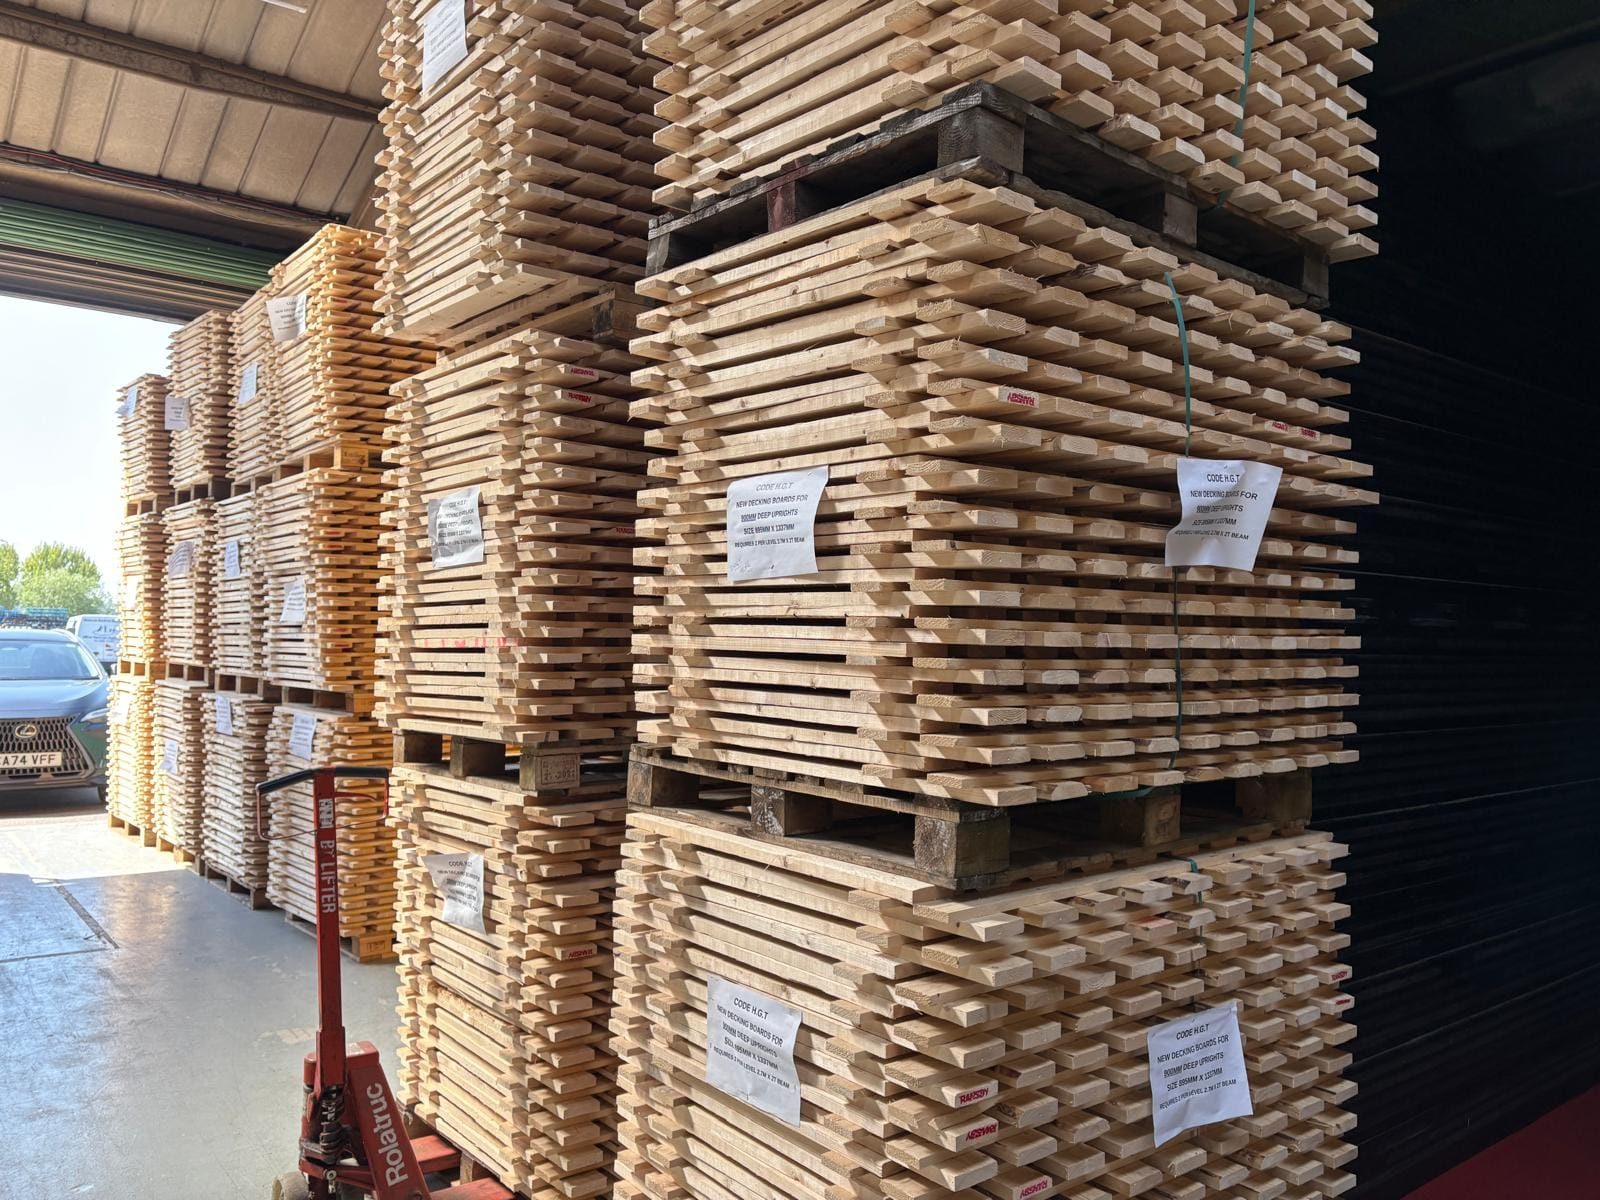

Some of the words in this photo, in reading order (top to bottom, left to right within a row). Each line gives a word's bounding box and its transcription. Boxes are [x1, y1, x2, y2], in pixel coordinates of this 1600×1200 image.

[1206, 474, 1223, 483] CODE
[756, 484, 775, 492] CODE
[748, 498, 771, 507] DECKING
[772, 496, 795, 504] BOARDS
[796, 494, 808, 502] FOR
[1191, 490, 1203, 498] NEW
[1240, 491, 1258, 500] FOR
[757, 512, 771, 520] DEEP
[772, 509, 798, 518] UPRIGHTS
[744, 527, 754, 535] SIZE
[1231, 532, 1249, 540] BEAM
[0, 756, 26, 766] A74
[32, 755, 57, 765] VFF
[320, 862, 337, 913] LIFTER
[734, 998, 751, 1012] CODE
[752, 1007, 769, 1020] H.G.T
[717, 1005, 727, 1016] NEW
[727, 1010, 750, 1028] DECKING
[750, 1020, 772, 1041] BOARDS
[772, 1034, 784, 1048] FOR
[1176, 1028, 1193, 1040] CODE
[1194, 1024, 1209, 1035] H.G.T
[737, 1030, 749, 1043] DEEP
[1157, 1053, 1171, 1064] NEW
[1171, 1045, 1195, 1059] DECKING
[1196, 1038, 1217, 1052] BOARDS
[1218, 1035, 1229, 1044] FOR
[1183, 1061, 1199, 1071] DEEP
[1199, 1052, 1224, 1066] UPRIGHTS
[743, 1062, 756, 1073] LEVEL
[777, 1078, 790, 1089] BEAM
[1167, 1081, 1178, 1092] SIZE
[1189, 1088, 1204, 1096] LEVEL
[1221, 1079, 1237, 1087] BEAM
[366, 1082, 409, 1187] Rolatruc
